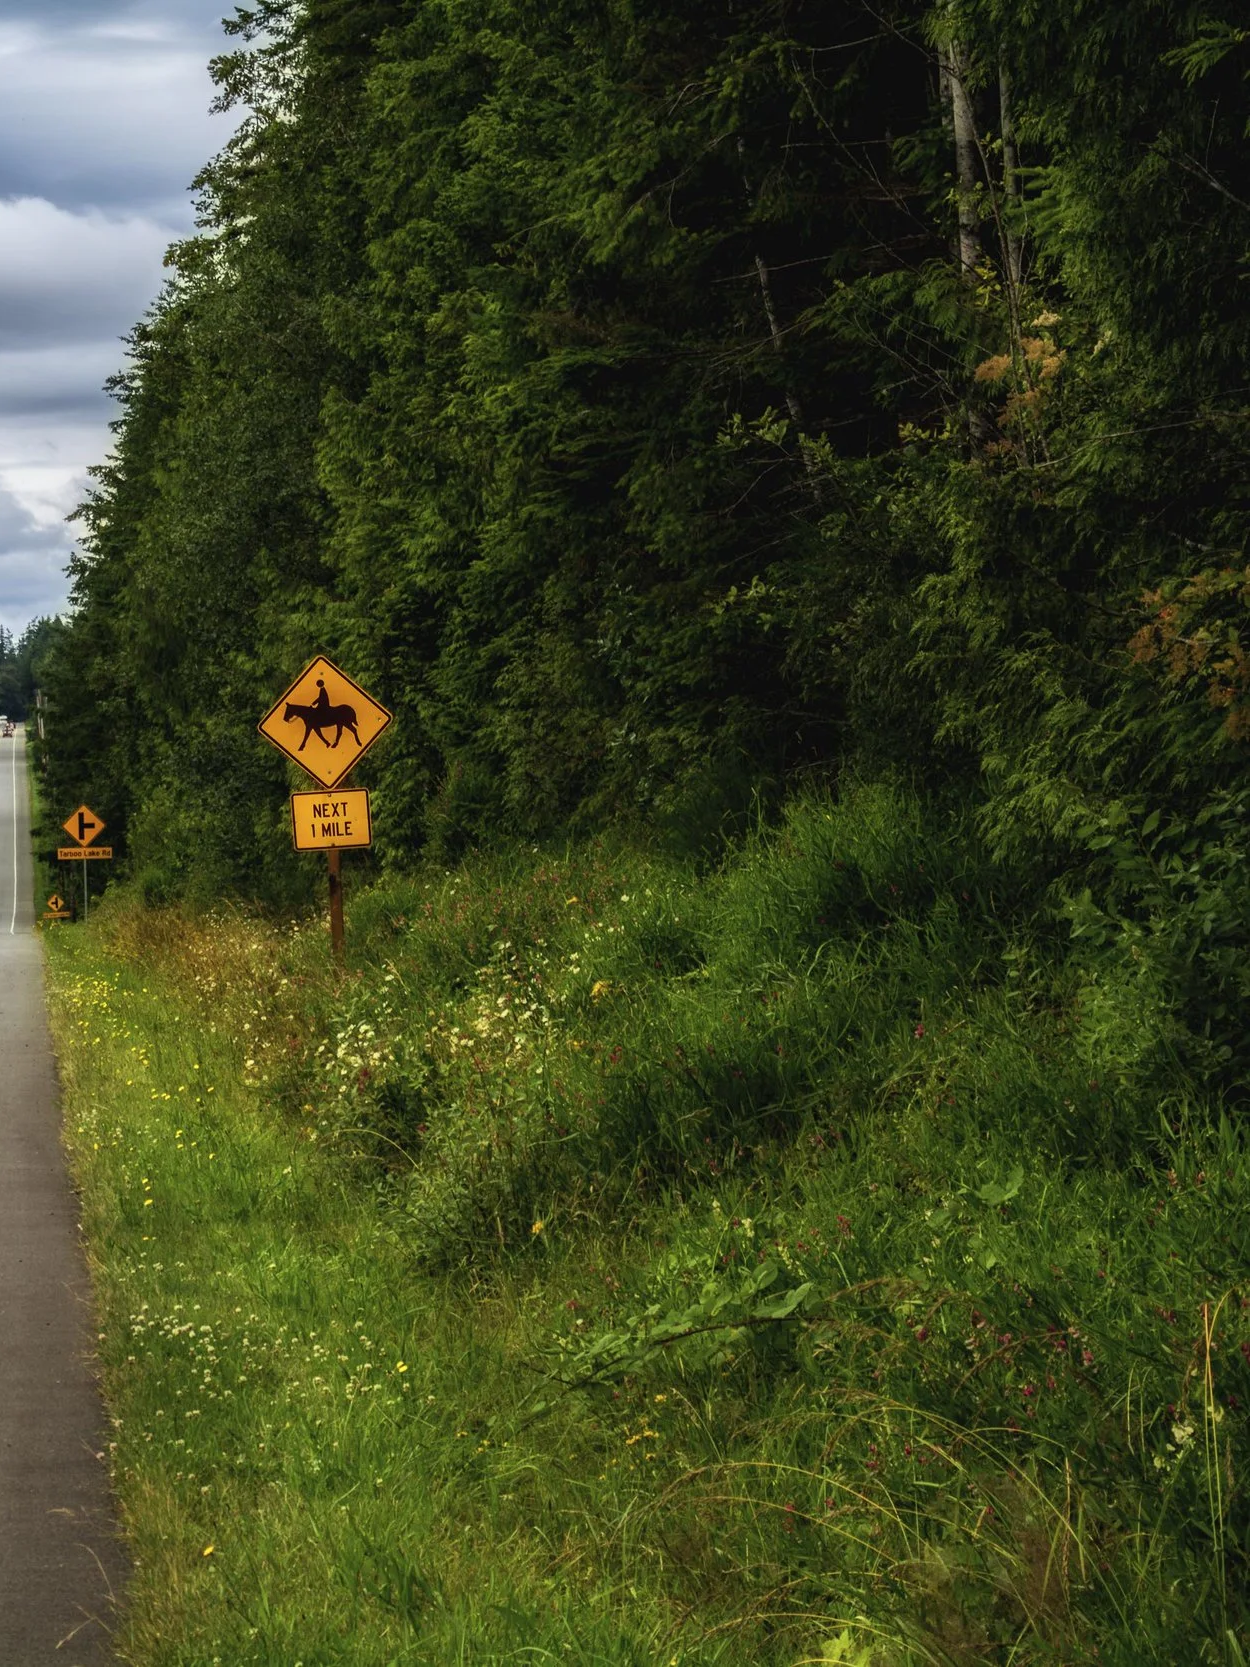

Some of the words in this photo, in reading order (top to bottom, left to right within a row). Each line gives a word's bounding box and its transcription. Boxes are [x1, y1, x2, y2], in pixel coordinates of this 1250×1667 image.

[313, 802, 347, 818] NEXT
[311, 823, 315, 837] 1
[321, 821, 352, 837] MILE
